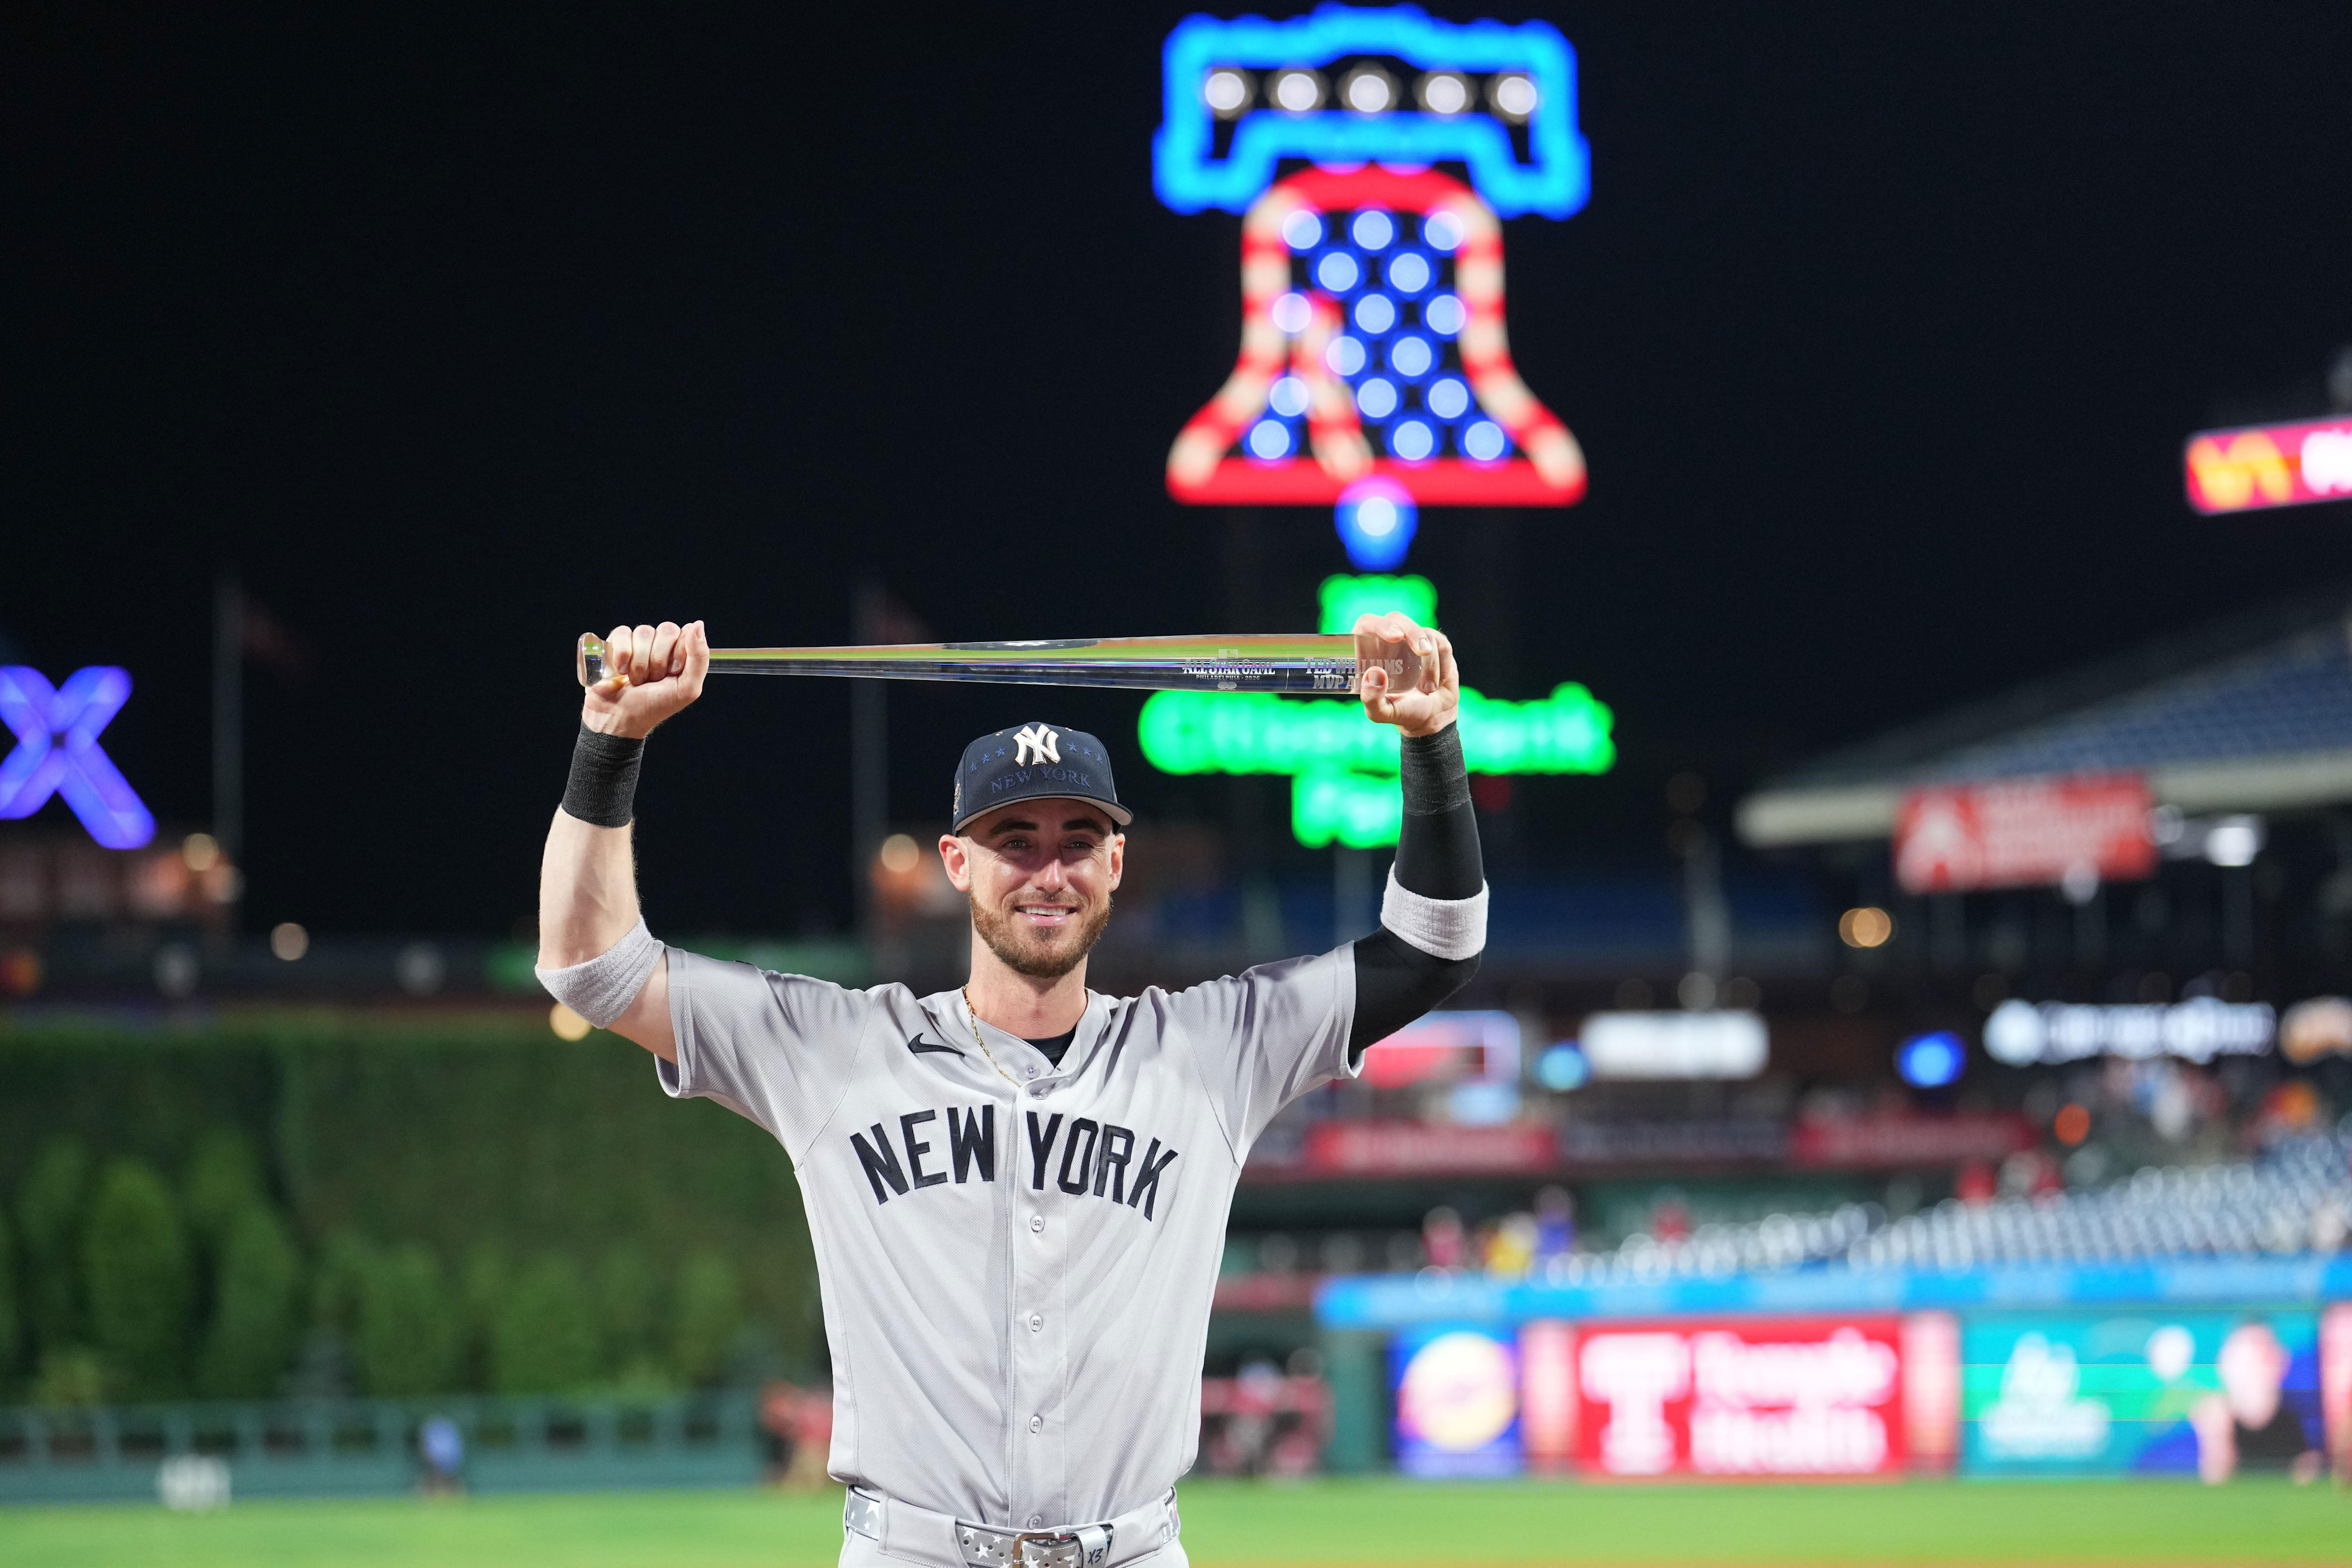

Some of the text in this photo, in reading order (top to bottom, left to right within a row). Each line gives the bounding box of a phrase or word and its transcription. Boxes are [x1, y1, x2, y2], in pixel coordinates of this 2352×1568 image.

[1241, 659, 1276, 674] GAME
[1305, 657, 1332, 674] TED
[1312, 675, 1344, 689] MVP
[1013, 724, 1061, 767] NY
[990, 767, 1092, 793] NEW YORK
[849, 1104, 1178, 1222] NEW YORK
